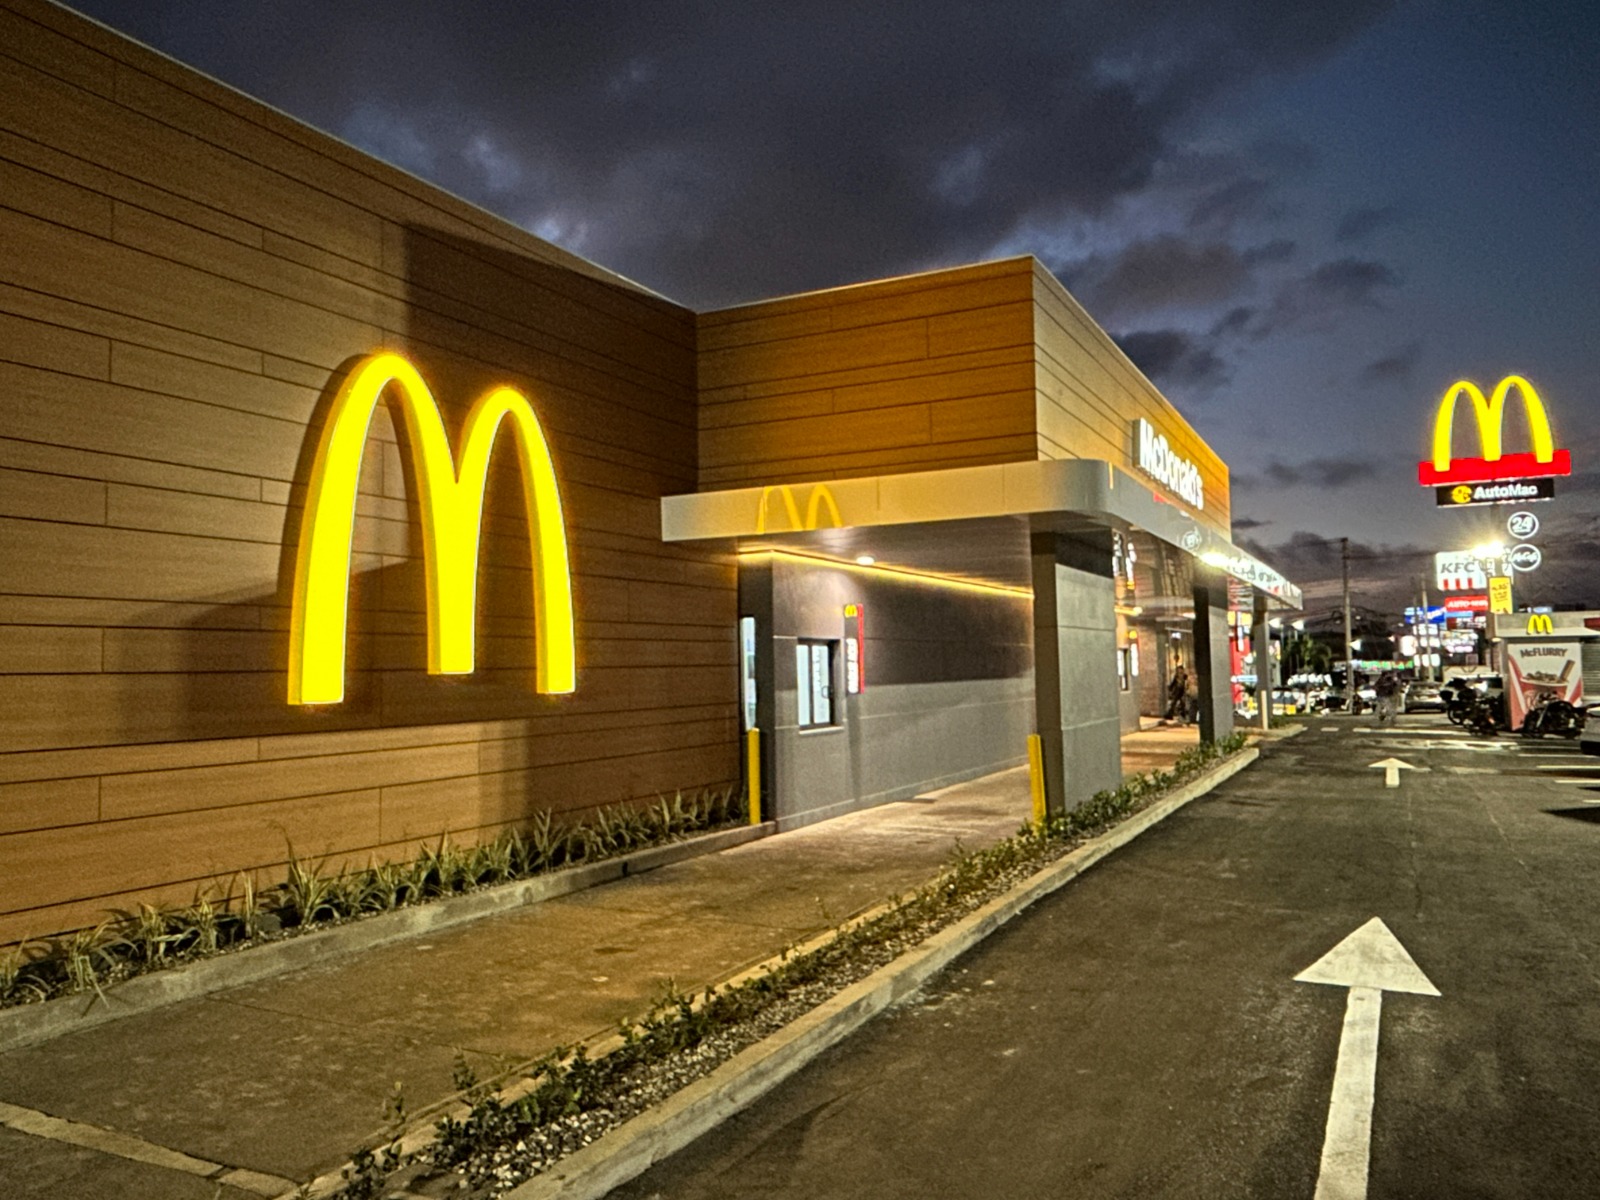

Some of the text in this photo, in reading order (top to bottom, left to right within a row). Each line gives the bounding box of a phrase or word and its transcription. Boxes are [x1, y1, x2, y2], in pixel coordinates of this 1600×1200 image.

[1474, 484, 1538, 500] AutoMac
[1511, 516, 1534, 532] 24
[1440, 561, 1475, 573] KFC
[1520, 647, 1568, 658] McFLURRY
